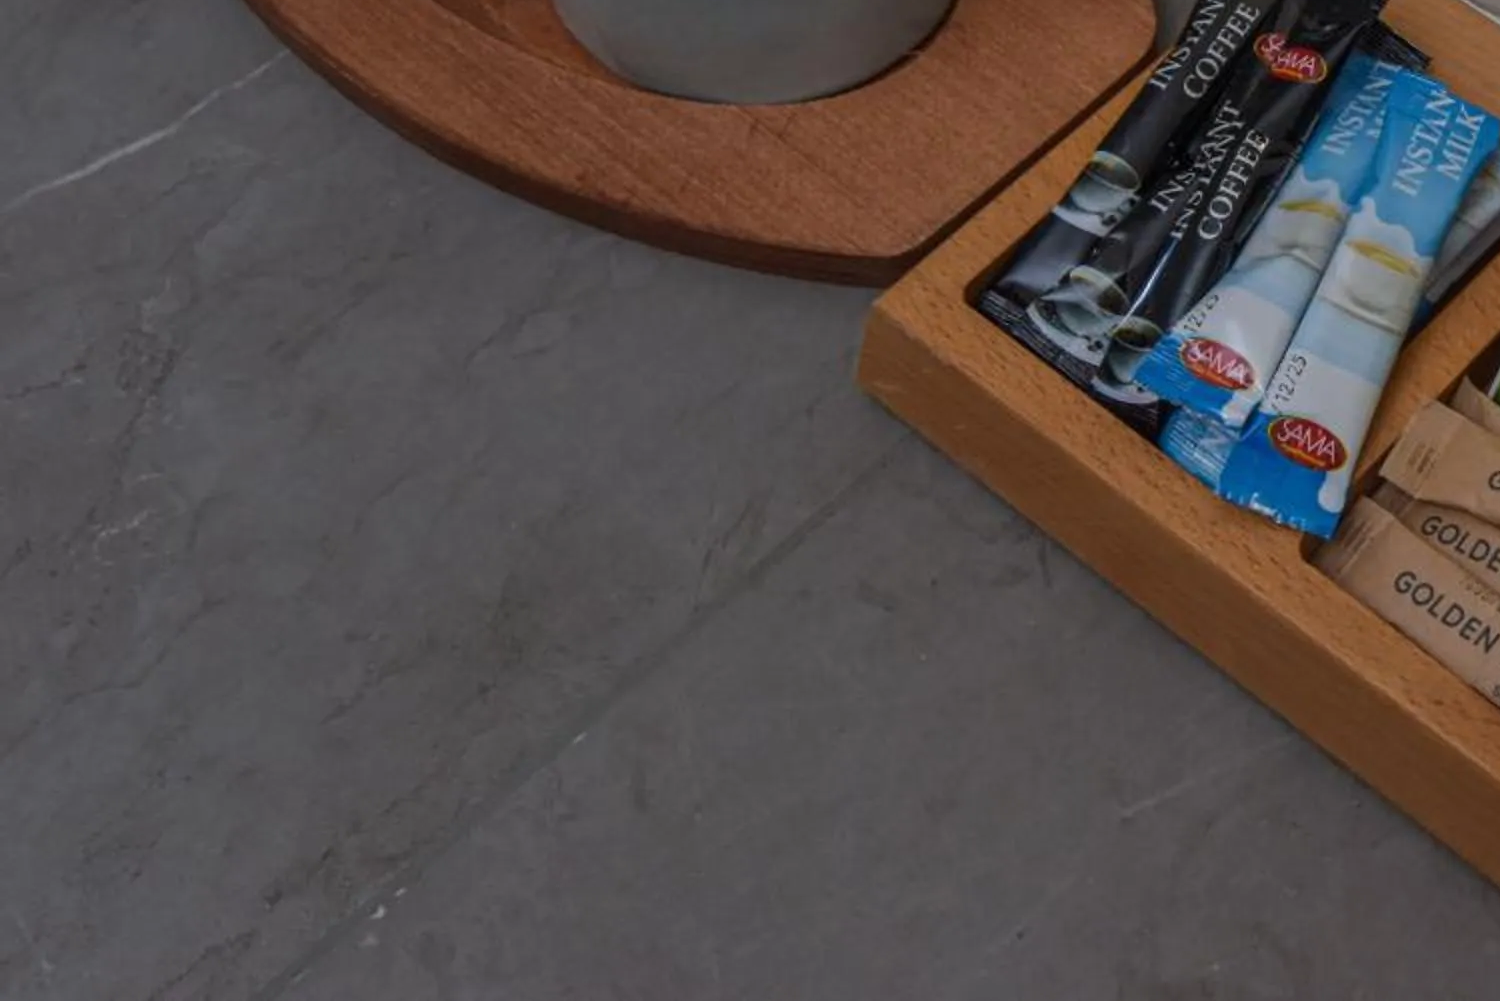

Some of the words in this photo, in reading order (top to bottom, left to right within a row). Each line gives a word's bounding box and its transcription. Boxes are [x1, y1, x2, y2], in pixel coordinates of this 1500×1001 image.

[1183, 2, 1260, 99] COFFEE
[1392, 89, 1457, 196] INSTAN
[1436, 102, 1486, 181] MILK
[1198, 129, 1270, 240] COFFEE
[1187, 339, 1247, 385] SAMA
[1277, 418, 1336, 464] SAMA
[1393, 570, 1500, 655] GOLDEN
